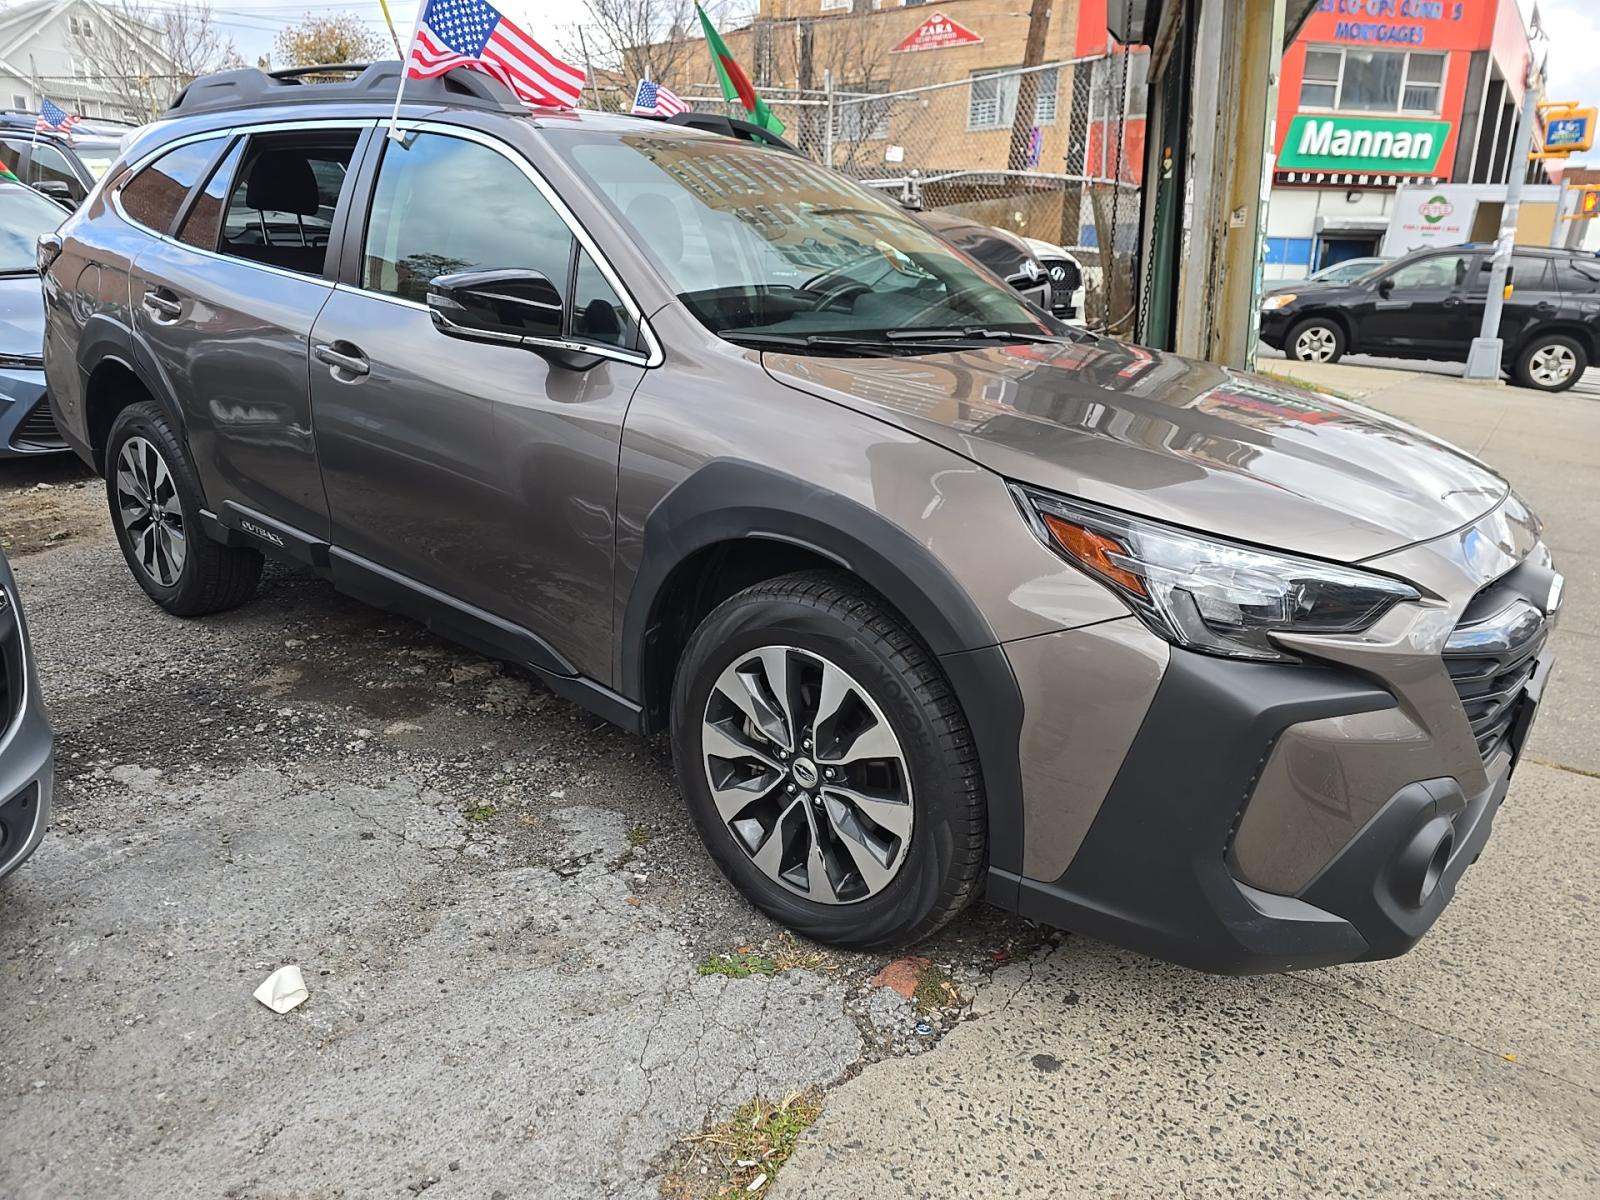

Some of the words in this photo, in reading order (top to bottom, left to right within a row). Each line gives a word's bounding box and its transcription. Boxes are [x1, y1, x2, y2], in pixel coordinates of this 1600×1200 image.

[919, 23, 953, 35] ZARA
[1334, 22, 1425, 44] MORTGAGES
[1297, 120, 1434, 159] Mannan
[1287, 172, 1438, 186] SUPERMARKET
[241, 520, 284, 546] OUTBACK
